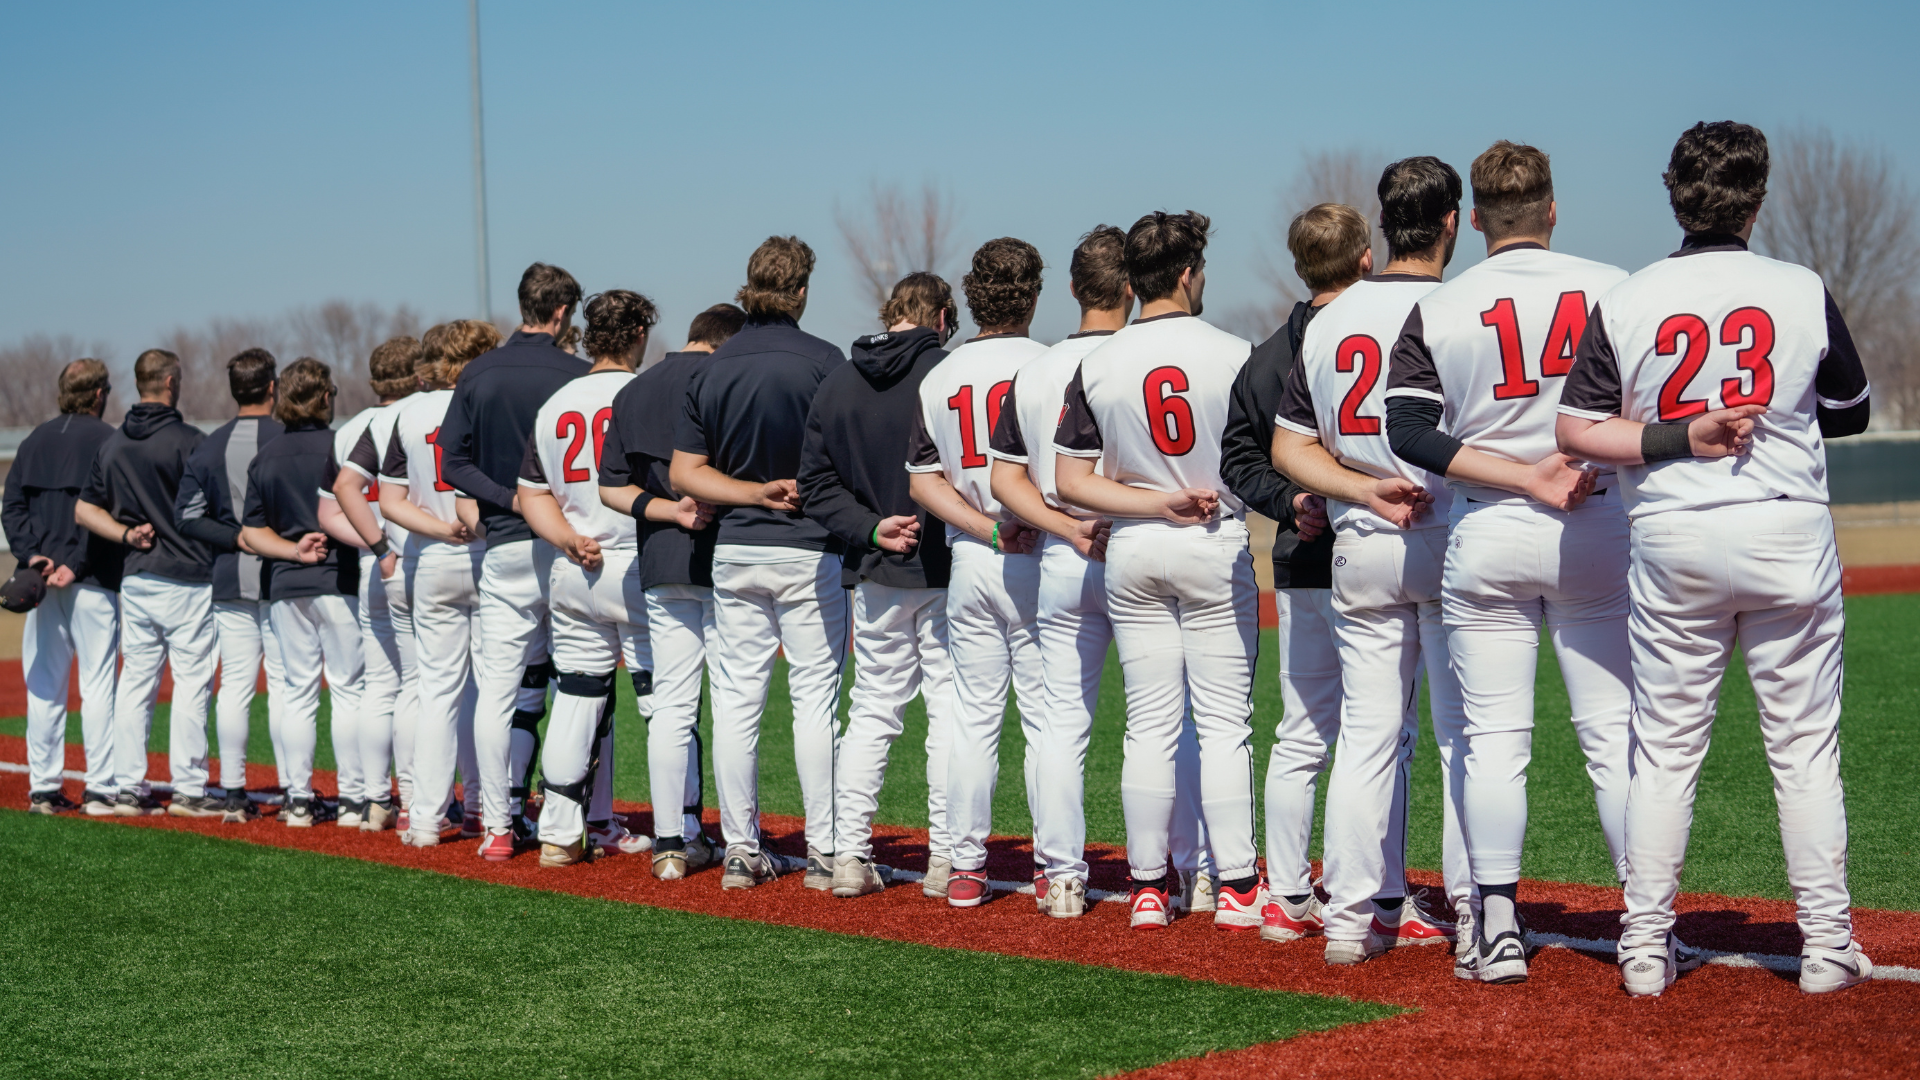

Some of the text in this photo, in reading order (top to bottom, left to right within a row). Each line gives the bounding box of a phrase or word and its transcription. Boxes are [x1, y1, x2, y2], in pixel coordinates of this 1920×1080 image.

[1480, 290, 1591, 401] 14
[1655, 306, 1775, 422] 23
[1143, 365, 1196, 456] 6
[1141, 901, 1157, 909] NIKE
[1503, 948, 1520, 957] NIKE
